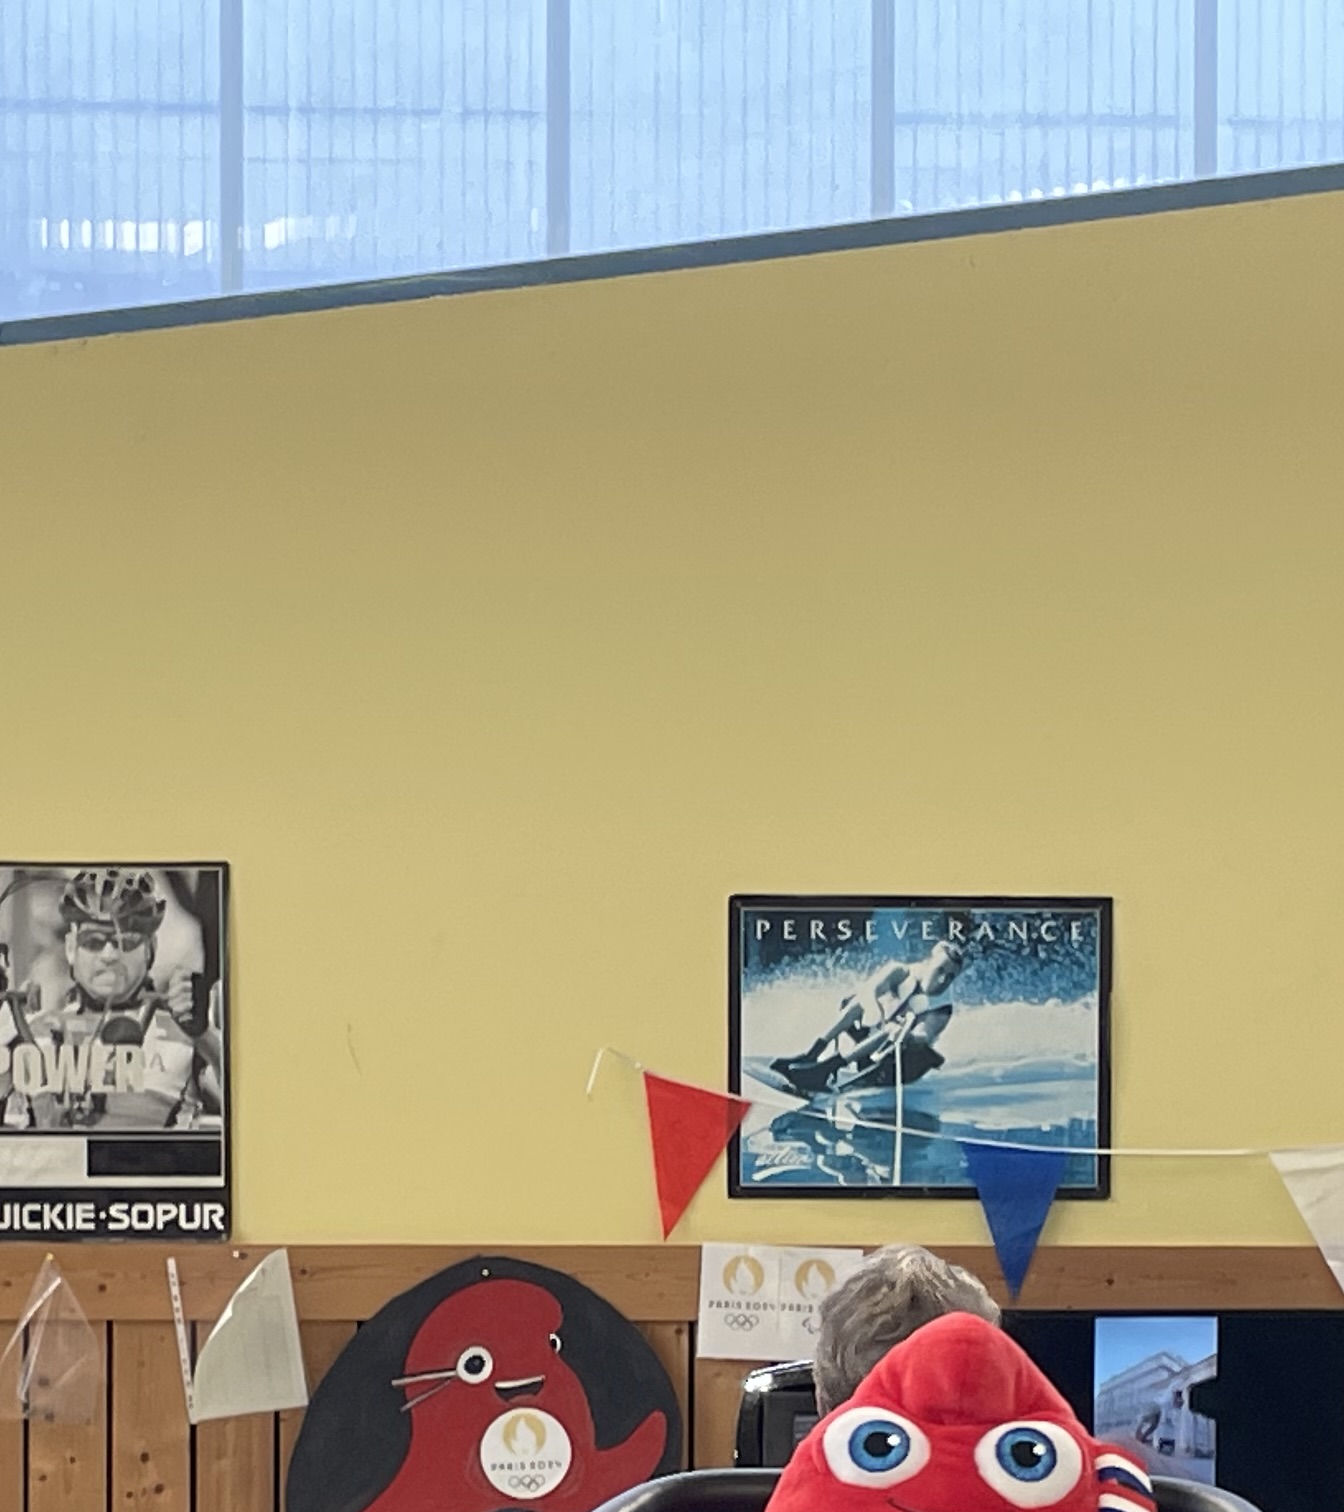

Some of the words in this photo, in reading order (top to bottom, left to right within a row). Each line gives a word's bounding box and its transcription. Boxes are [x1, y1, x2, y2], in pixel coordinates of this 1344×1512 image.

[755, 919, 1084, 941] PERSEVERANCE
[708, 1300, 743, 1310] PARIS
[745, 1301, 776, 1311] 2024
[780, 1303, 814, 1313] PARIS
[490, 1461, 527, 1471] PARIS
[529, 1460, 562, 1471] 2024
